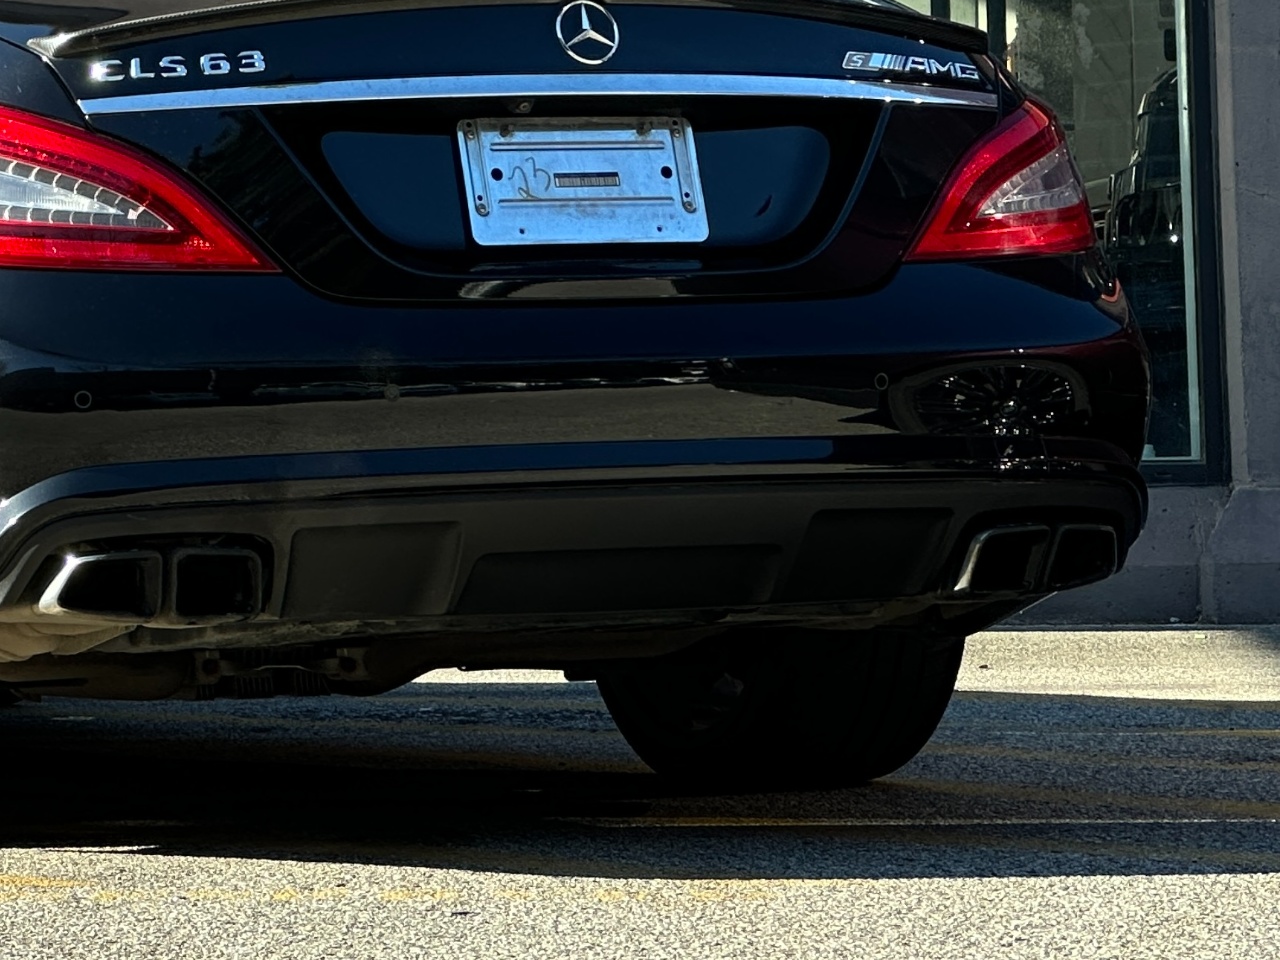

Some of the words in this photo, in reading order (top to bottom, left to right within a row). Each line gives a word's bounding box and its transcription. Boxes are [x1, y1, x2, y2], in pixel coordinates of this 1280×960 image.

[90, 55, 188, 82] CLS
[200, 50, 266, 75] 63
[905, 56, 980, 80] AMG
